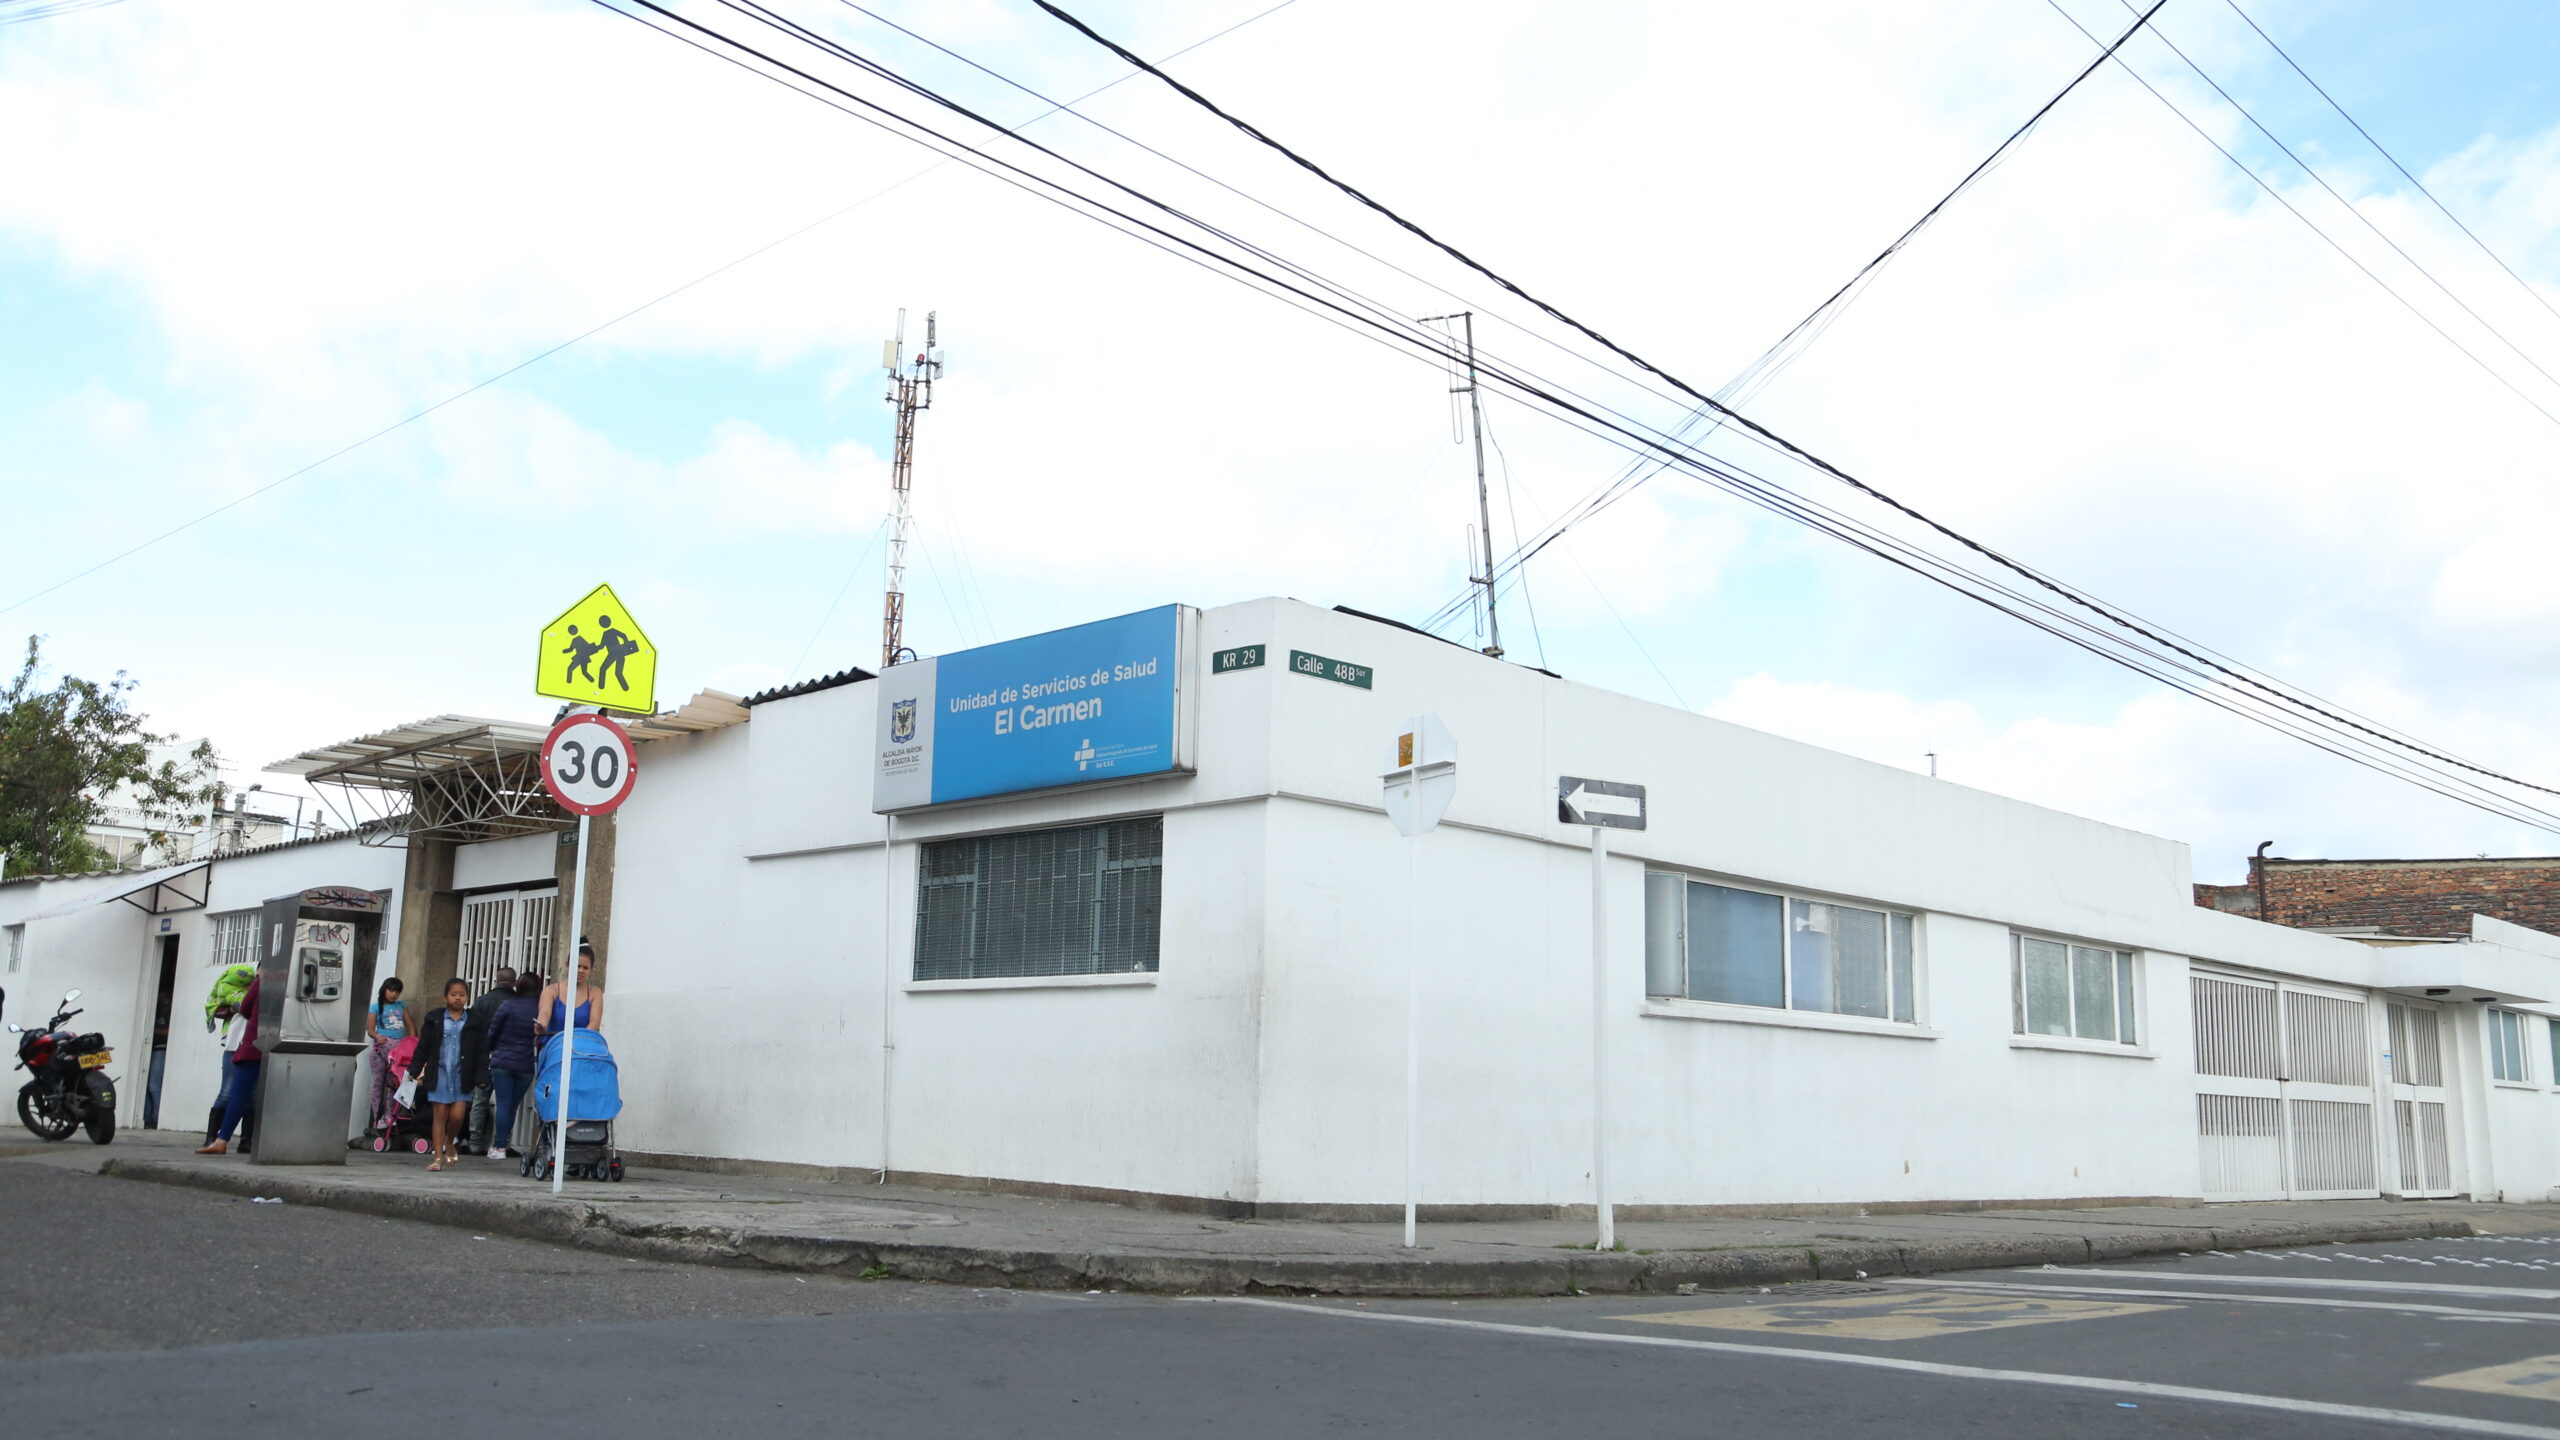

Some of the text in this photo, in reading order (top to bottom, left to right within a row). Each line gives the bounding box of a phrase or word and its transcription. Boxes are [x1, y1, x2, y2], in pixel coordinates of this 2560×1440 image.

[1222, 648, 1256, 669] KR 29
[1296, 655, 1324, 675] Calle
[1334, 663, 1355, 682] 48B
[950, 657, 1157, 713] Unidad de Servicios de Salud
[994, 697, 1102, 735] El Carmen
[557, 740, 619, 789] 30
[906, 746, 923, 754] MAYOR
